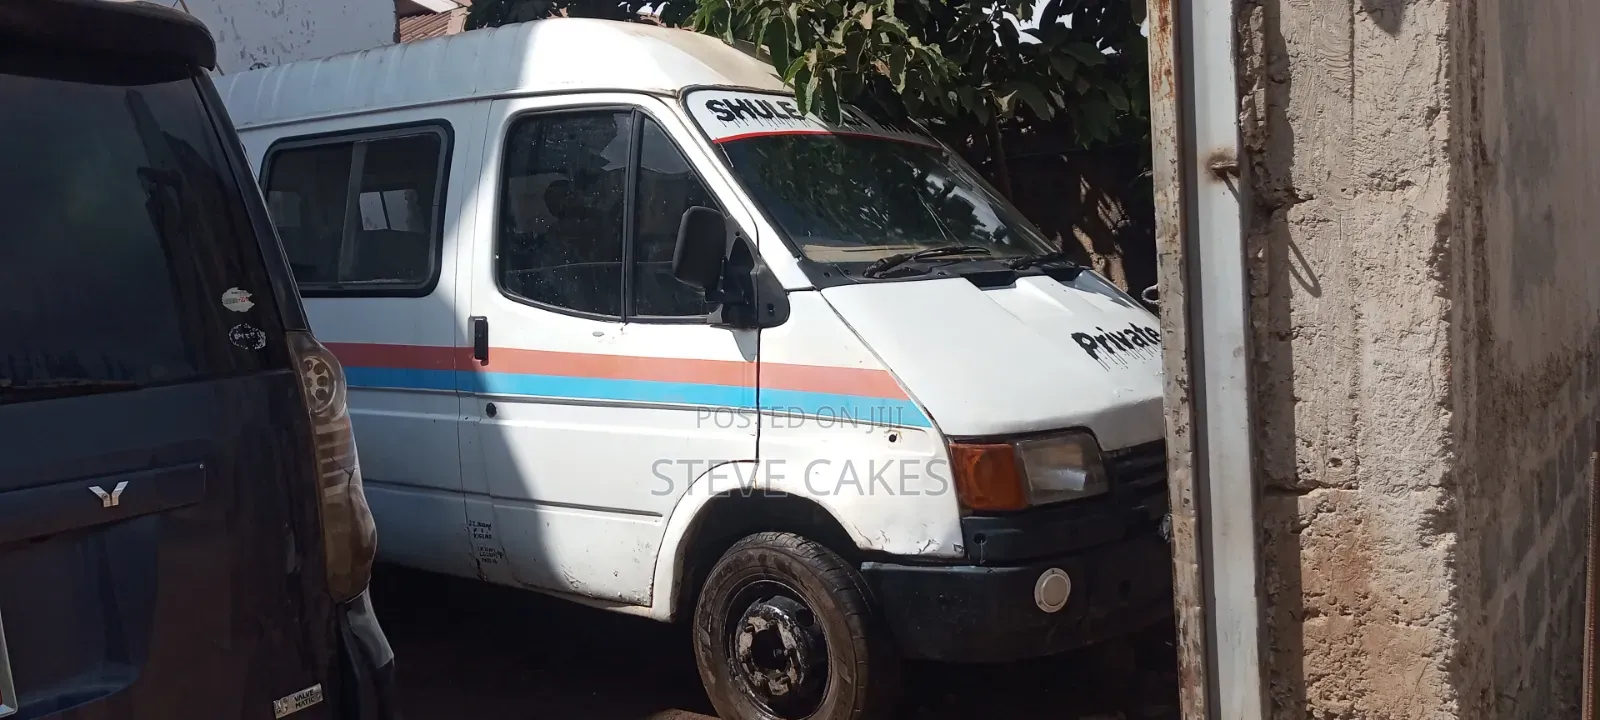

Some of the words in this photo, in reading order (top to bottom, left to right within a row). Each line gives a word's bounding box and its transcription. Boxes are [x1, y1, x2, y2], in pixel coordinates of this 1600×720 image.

[705, 98, 806, 124] SHULE
[1071, 322, 1161, 361] Private
[294, 689, 314, 702] VALVE
[295, 696, 315, 709] MATIC
